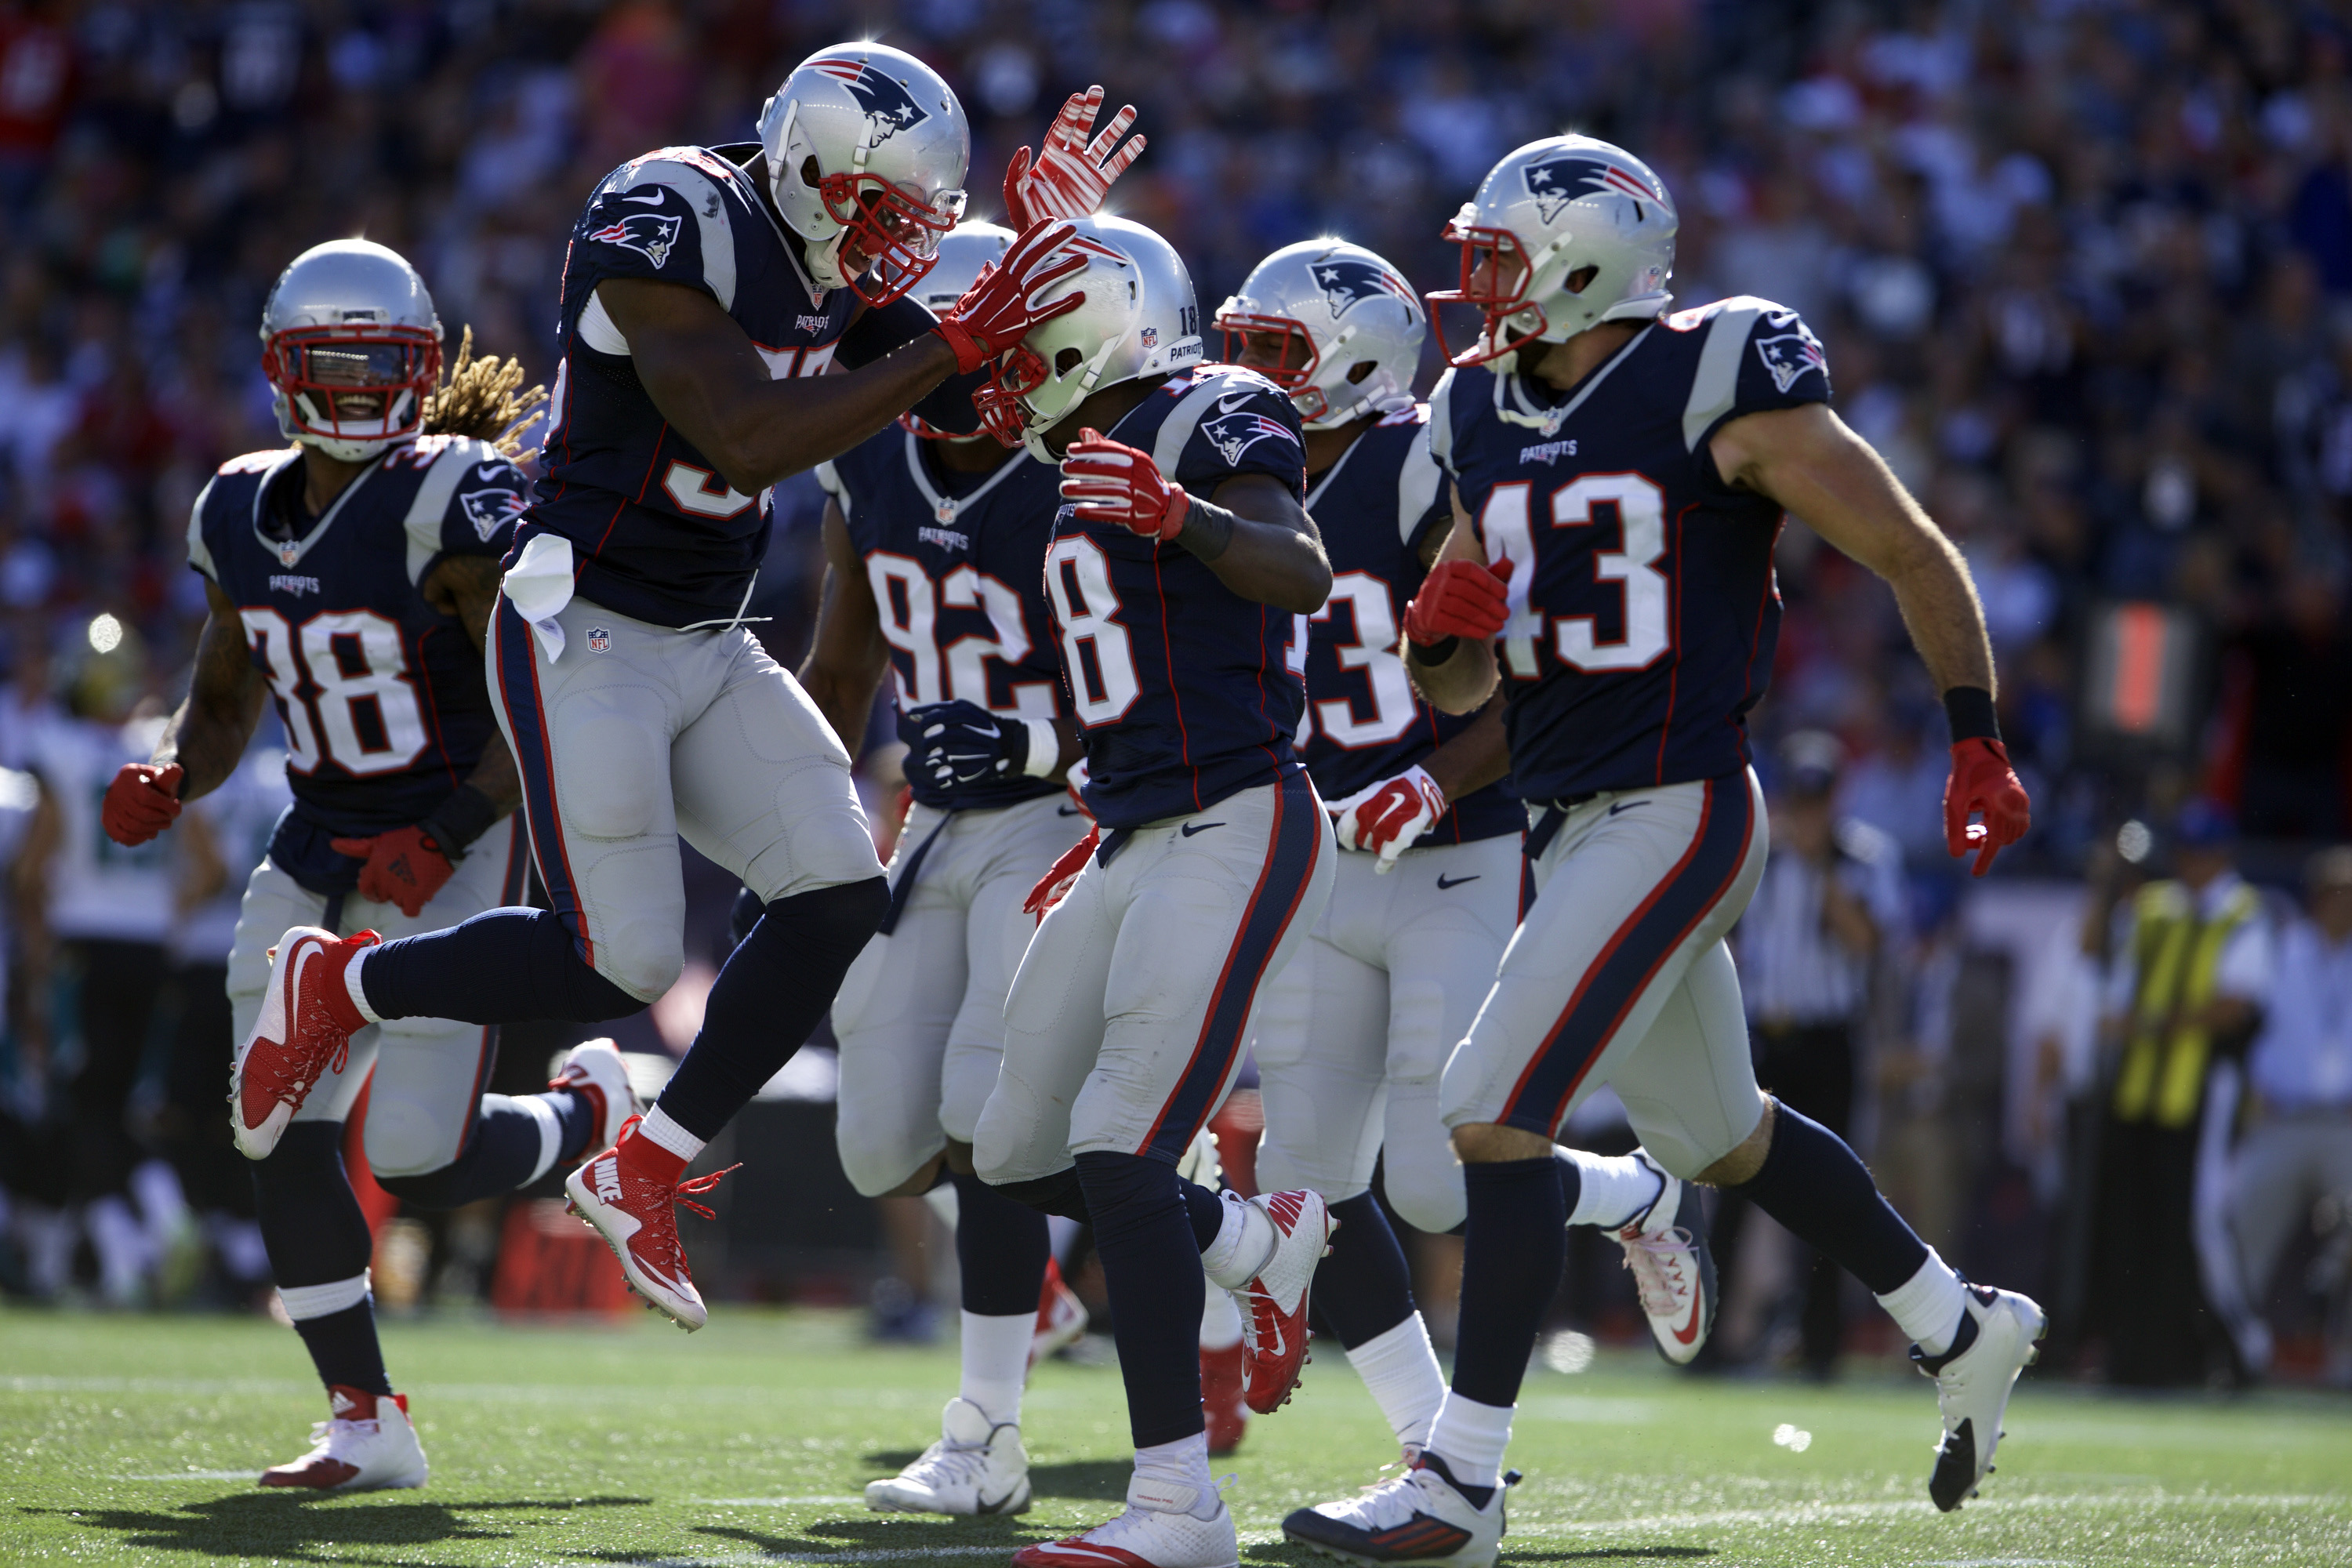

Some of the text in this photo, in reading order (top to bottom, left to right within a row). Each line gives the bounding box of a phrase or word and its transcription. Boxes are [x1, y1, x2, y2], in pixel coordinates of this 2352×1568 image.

[1143, 336, 1156, 346] NFL
[1179, 306, 1196, 336] 18
[1479, 470, 1672, 681] 43
[591, 639, 608, 650] NFL
[864, 548, 1061, 720] 92
[1292, 568, 1421, 752] 3
[238, 605, 432, 779] 38
[594, 1156, 623, 1205] NIKE
[1267, 1191, 1307, 1239] NIK
